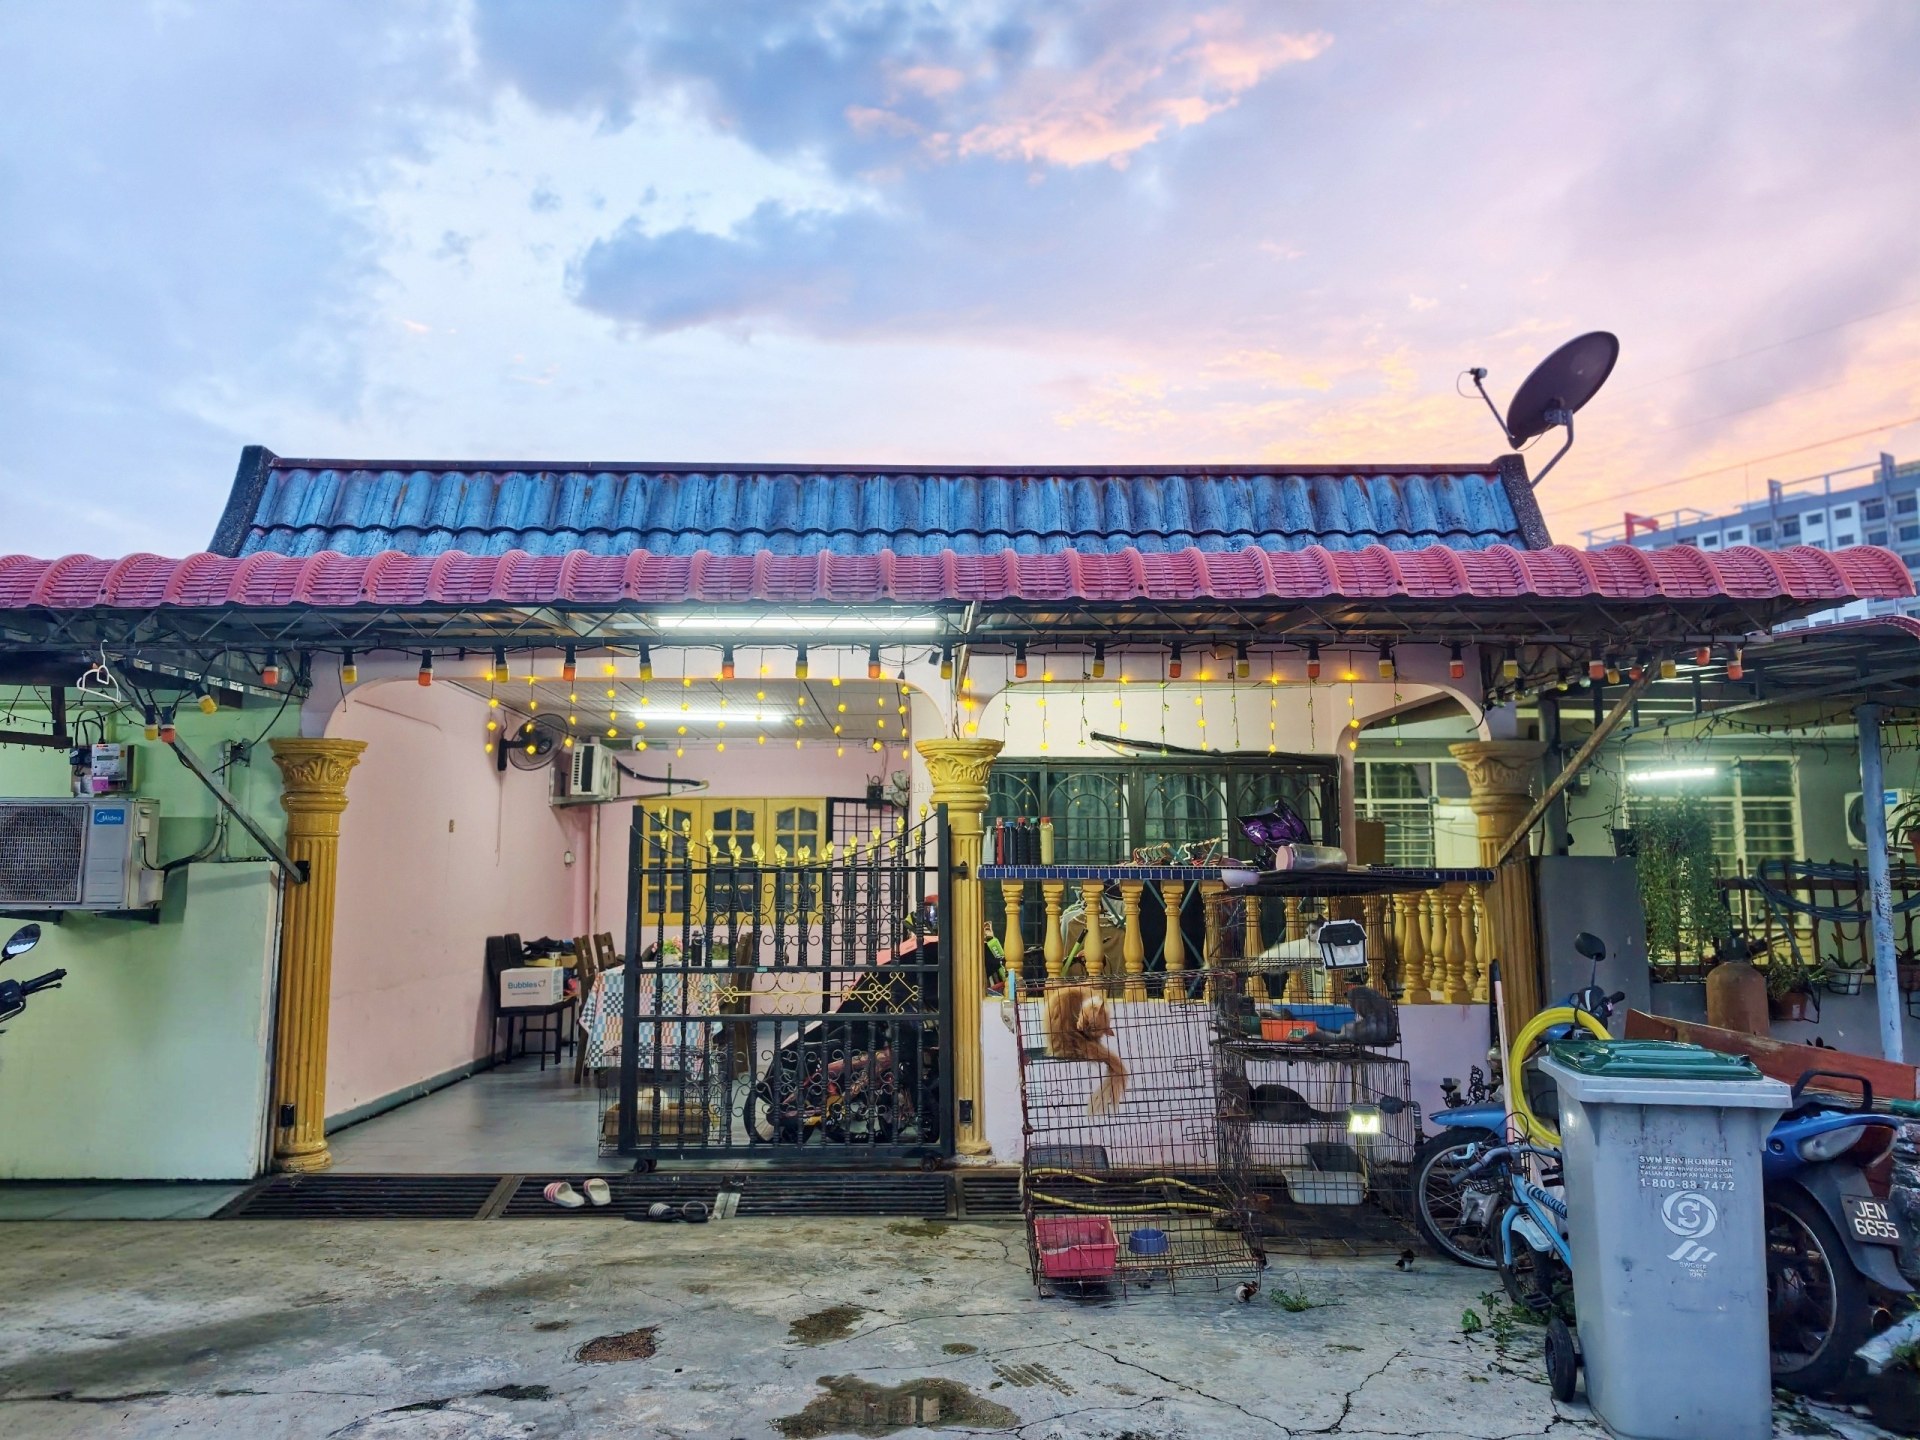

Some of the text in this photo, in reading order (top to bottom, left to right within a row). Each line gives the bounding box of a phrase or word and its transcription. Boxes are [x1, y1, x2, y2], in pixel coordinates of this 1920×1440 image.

[507, 981, 537, 989] Bubbles
[1639, 1156, 1733, 1166] SWM ENVIRONMENT
[1855, 1201, 1889, 1220] JEN
[1854, 1218, 1900, 1239] 6655
